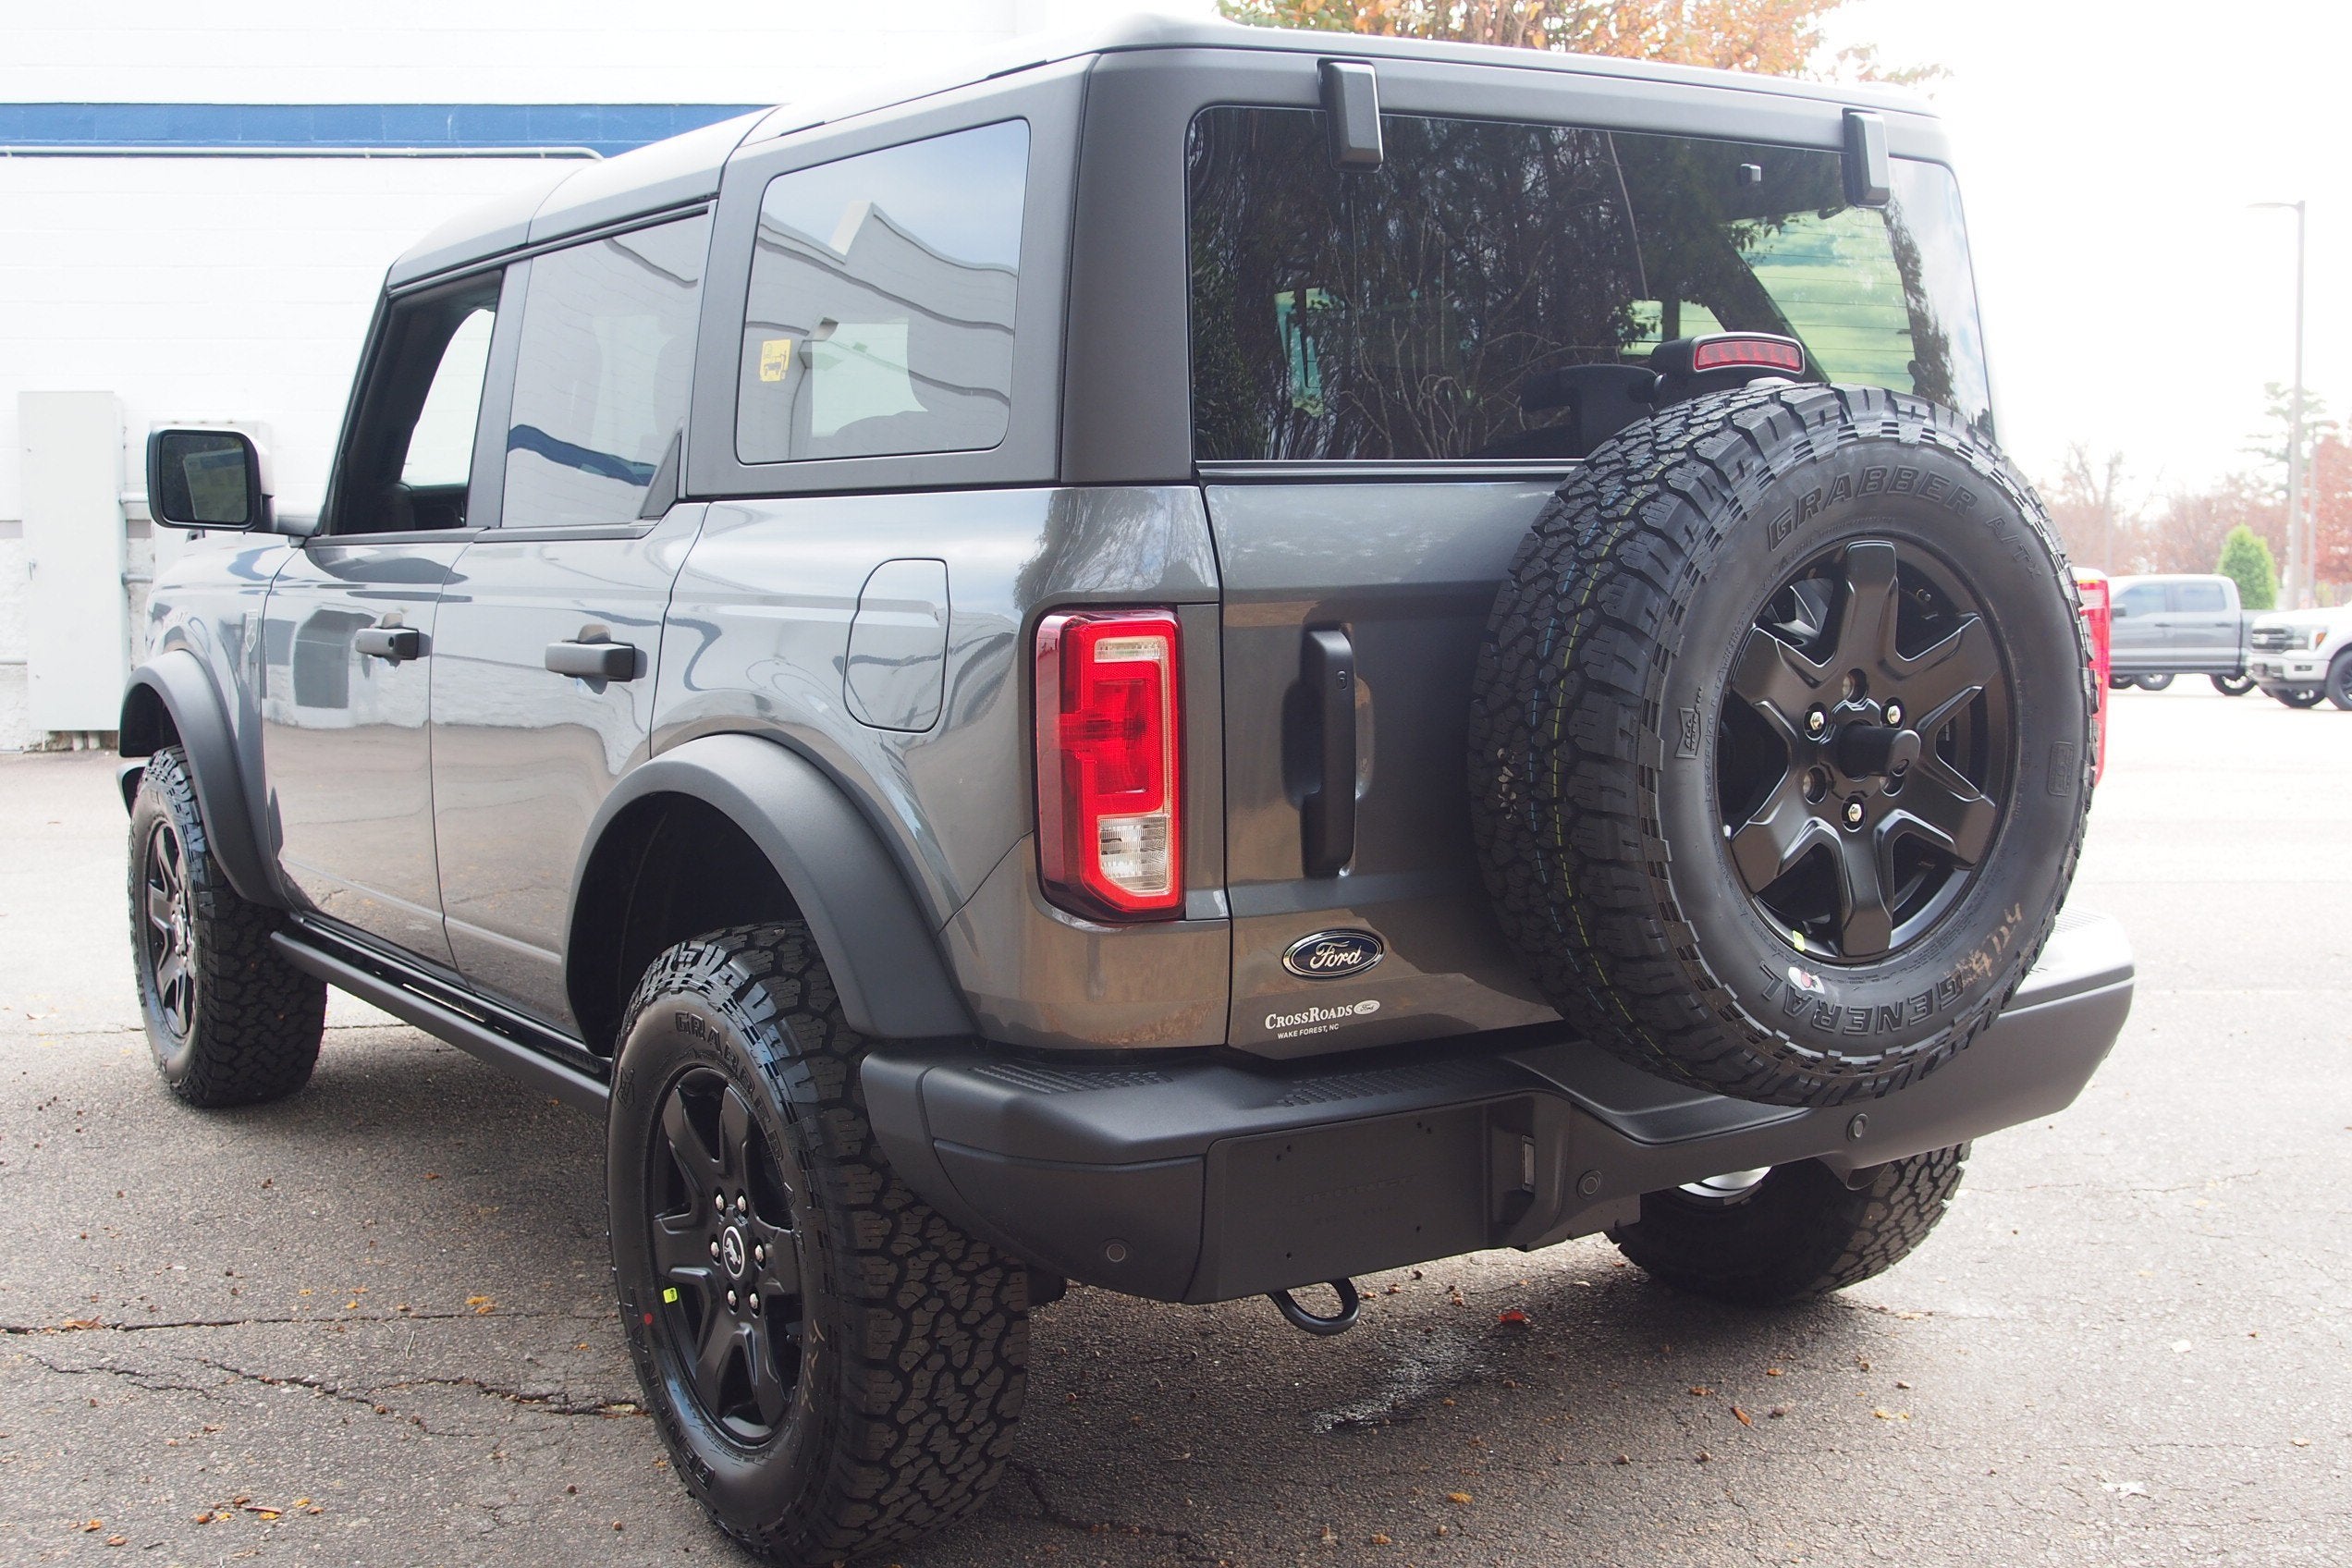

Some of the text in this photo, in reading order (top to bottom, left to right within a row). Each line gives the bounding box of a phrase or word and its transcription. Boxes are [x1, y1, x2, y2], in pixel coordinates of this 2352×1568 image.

[1768, 464, 1978, 552] GRABBER
[1309, 940, 1363, 969] Ford
[1277, 1023, 1340, 1040] WAKE FOREST, NC
[1758, 960, 1965, 1035] GENERAL
[674, 1011, 784, 1160] GRABBER
